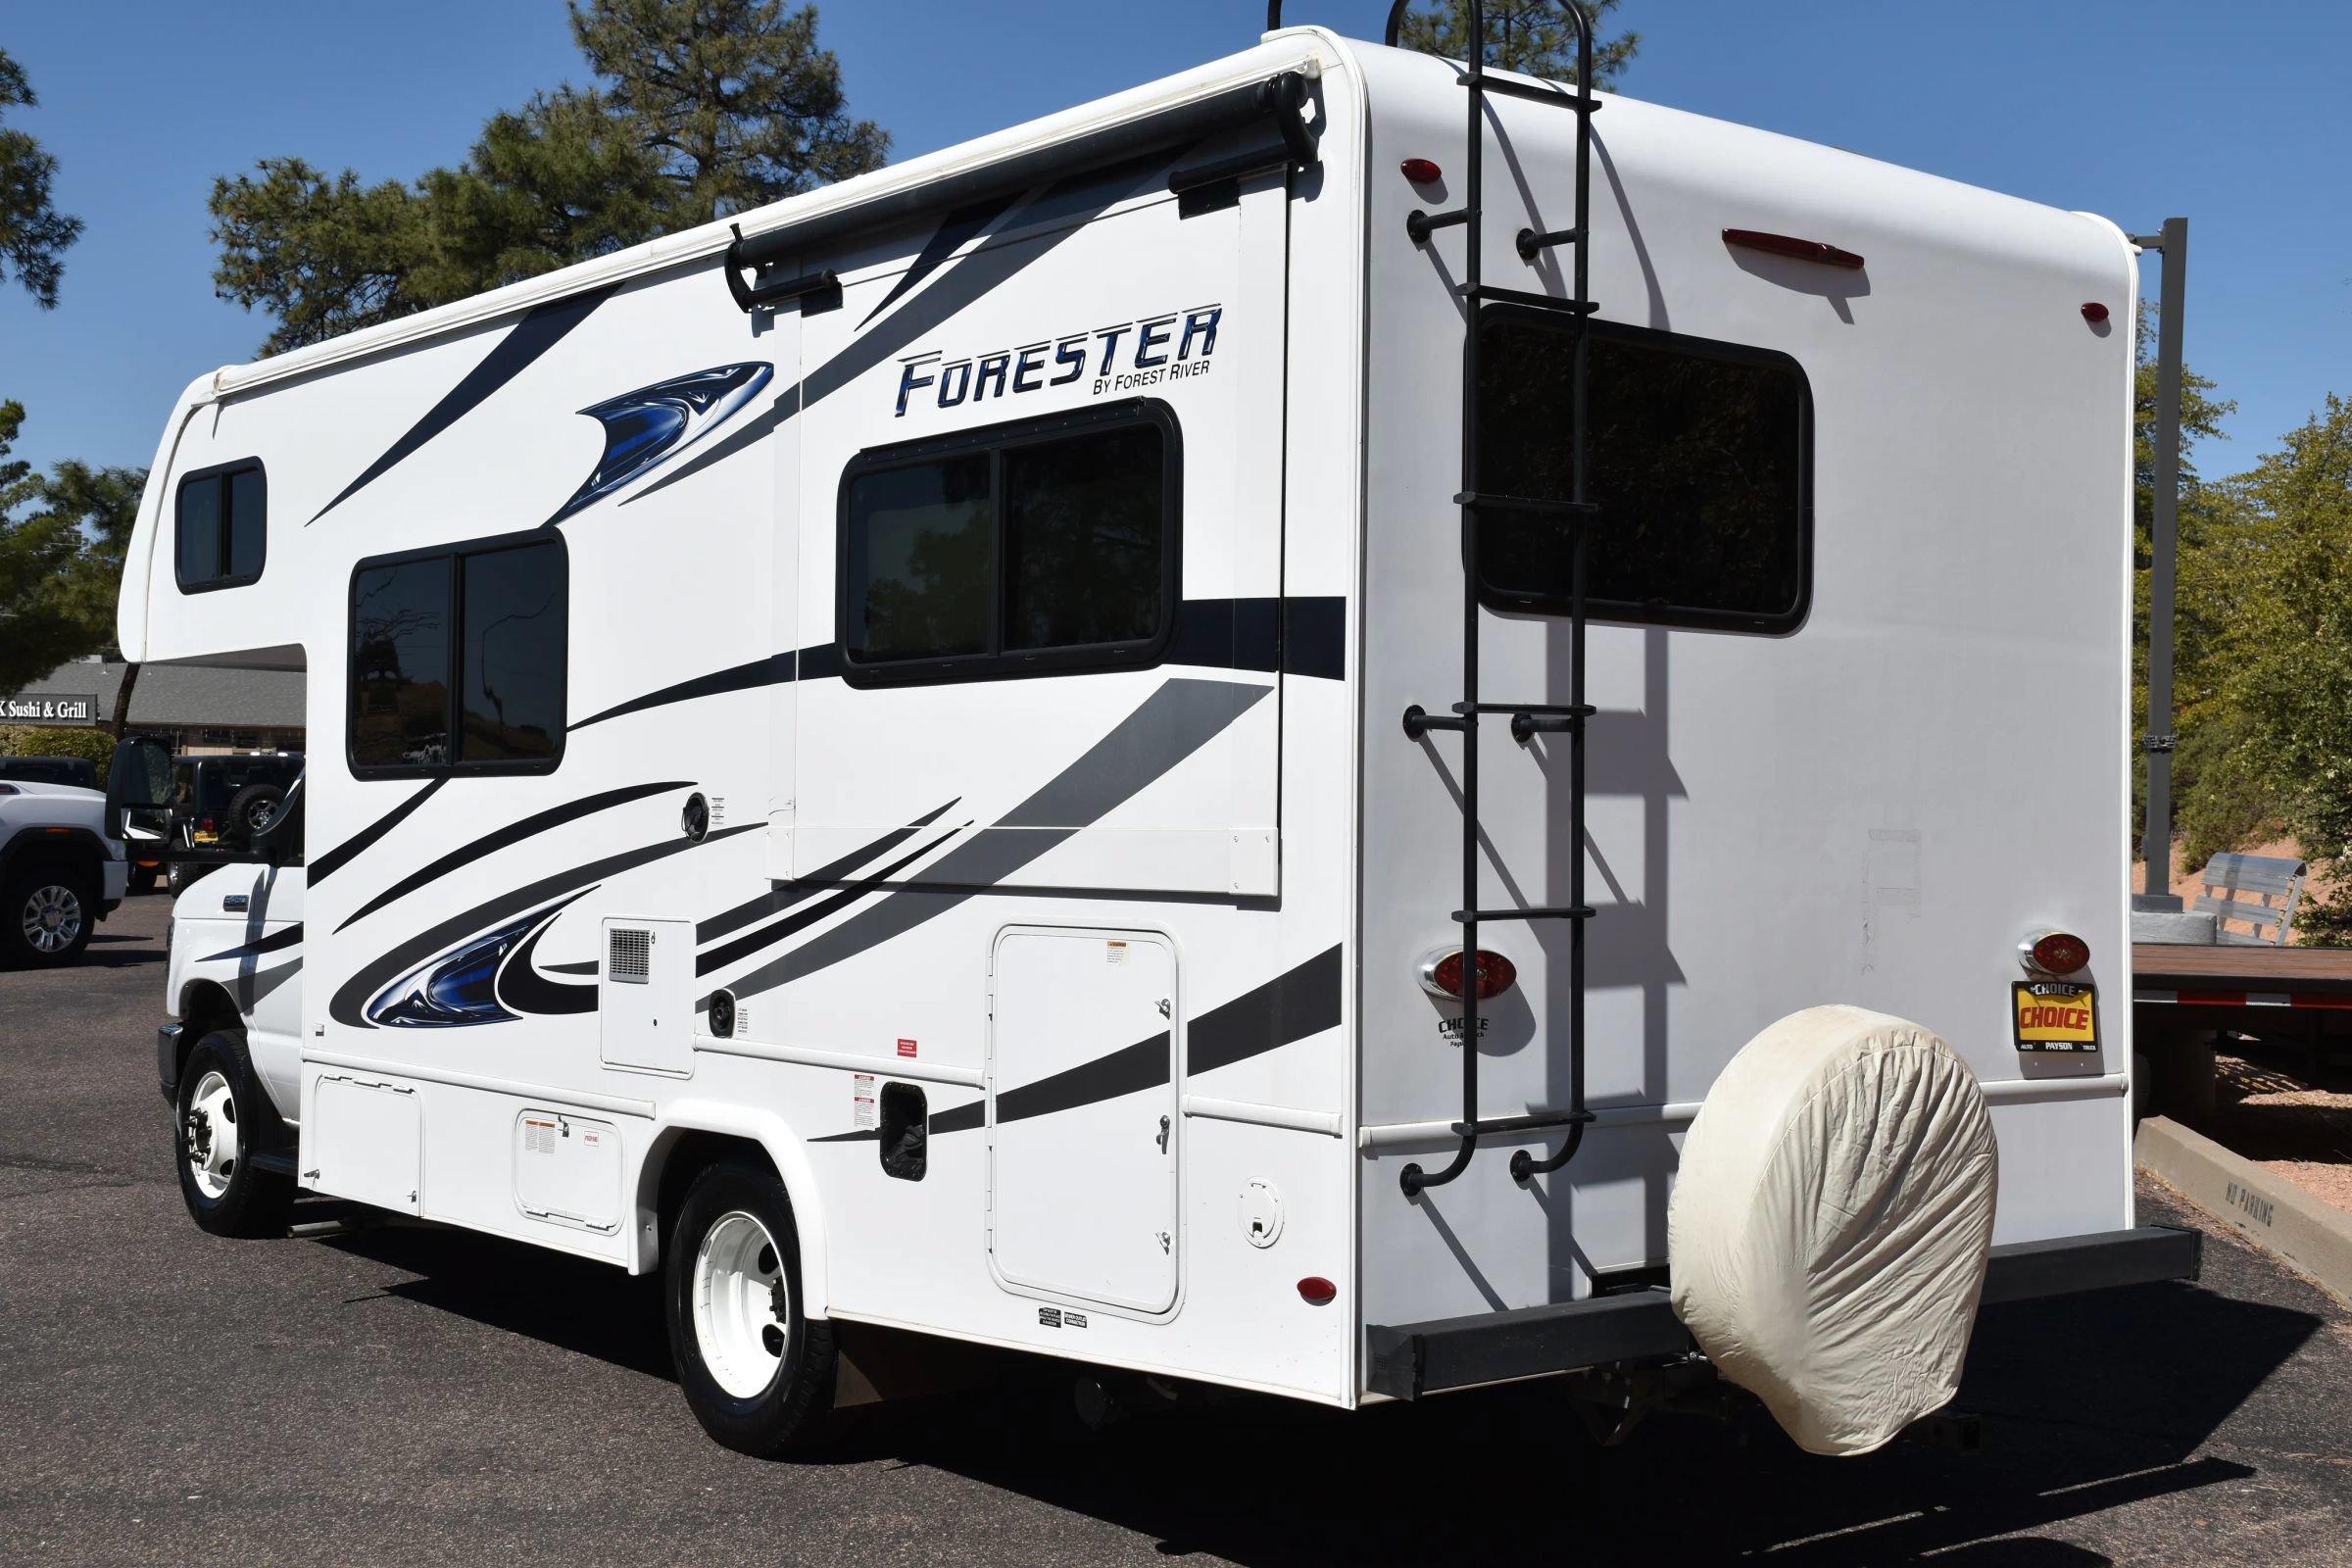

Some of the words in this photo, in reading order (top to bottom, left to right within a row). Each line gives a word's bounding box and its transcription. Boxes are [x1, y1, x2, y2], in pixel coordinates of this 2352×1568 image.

[895, 304, 1222, 417] FORESTER
[1093, 379, 1111, 395] BY
[1115, 368, 1166, 391] FOREST
[1170, 361, 1210, 380] RIVER
[9, 701, 40, 717] Sushi
[43, 701, 54, 717] &
[58, 702, 86, 718] Grill
[2034, 983, 2076, 997] CHOICE
[2020, 1006, 2090, 1030] CHOICE
[2045, 1042, 2073, 1051] PAYSON
[2226, 1181, 2237, 1205] NO
[2238, 1189, 2274, 1228] PARKING
